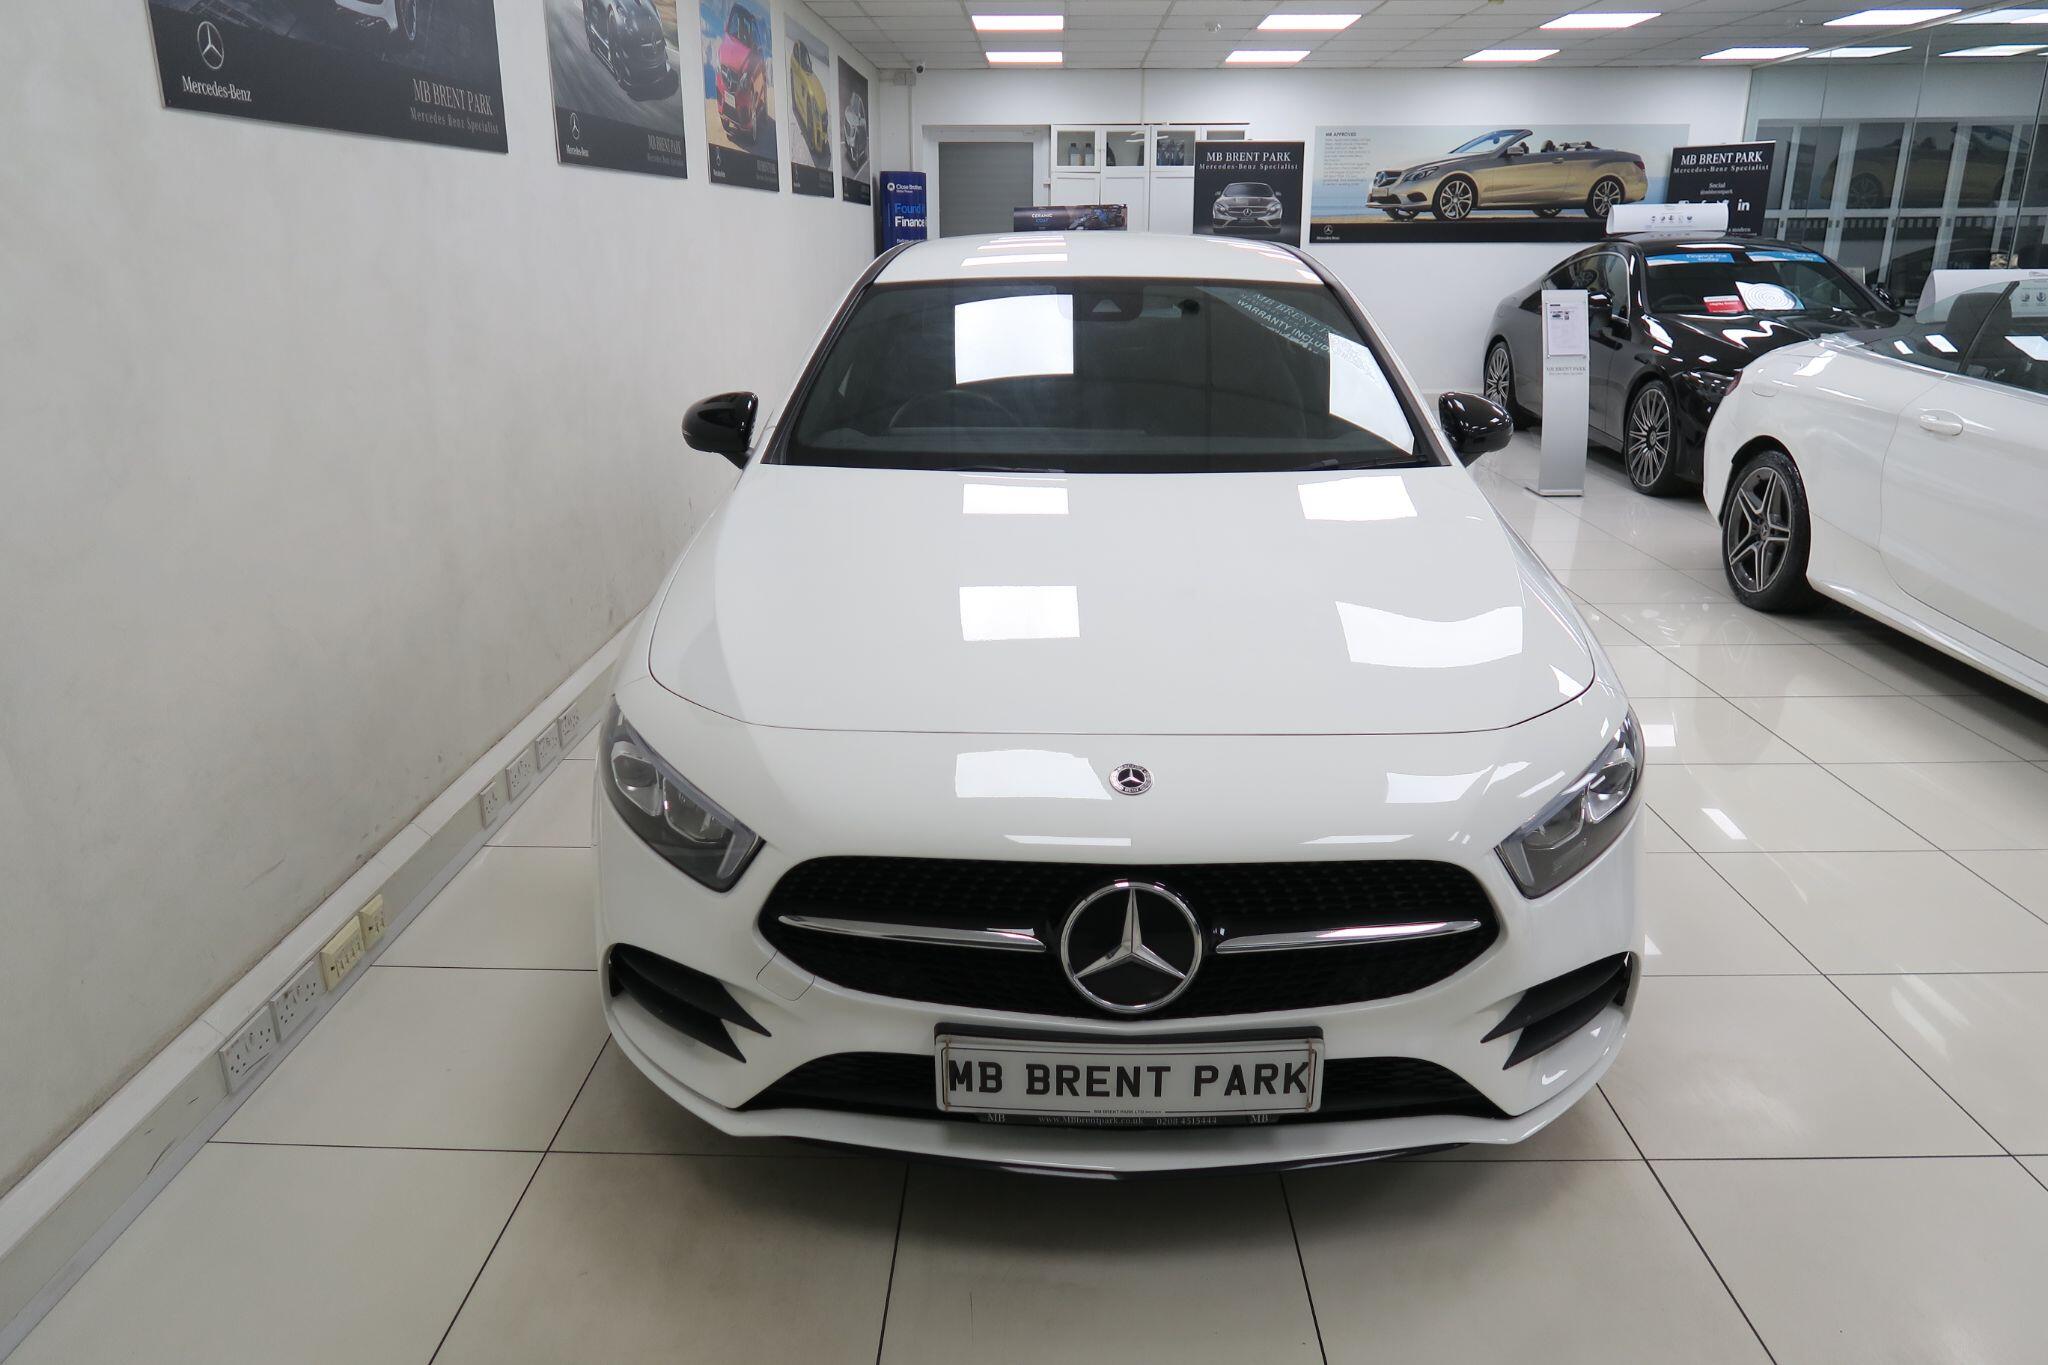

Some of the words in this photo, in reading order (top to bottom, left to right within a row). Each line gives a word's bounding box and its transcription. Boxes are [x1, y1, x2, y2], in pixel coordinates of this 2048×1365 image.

[182, 75, 252, 102] Mercedes-Benz
[412, 78, 431, 104] MB
[432, 83, 465, 110] BRENT
[467, 91, 493, 116] PARK
[467, 119, 499, 136] Specialist
[1206, 152, 1223, 162] MB
[1226, 152, 1260, 162] BRENT
[1263, 152, 1291, 162] PARK
[1680, 154, 1697, 166] MB
[1699, 152, 1733, 165] BRENT
[1735, 151, 1763, 163] PARK
[1259, 163, 1298, 171] Specialist
[1673, 166, 1728, 174] Mercedes-Benz
[1730, 164, 1769, 173] Specialist
[895, 203, 921, 214] Found
[1737, 198, 1750, 211] in
[1276, 303, 1320, 328] BRENT
[1237, 299, 1292, 331] WARRANTY
[1291, 328, 1330, 353] INCLUD
[948, 1060, 1003, 1094] MB
[1026, 1063, 1171, 1098] BRENT
[1193, 1061, 1309, 1097] PARK
[987, 1113, 1006, 1123] MB
[1251, 1114, 1269, 1123] MB
